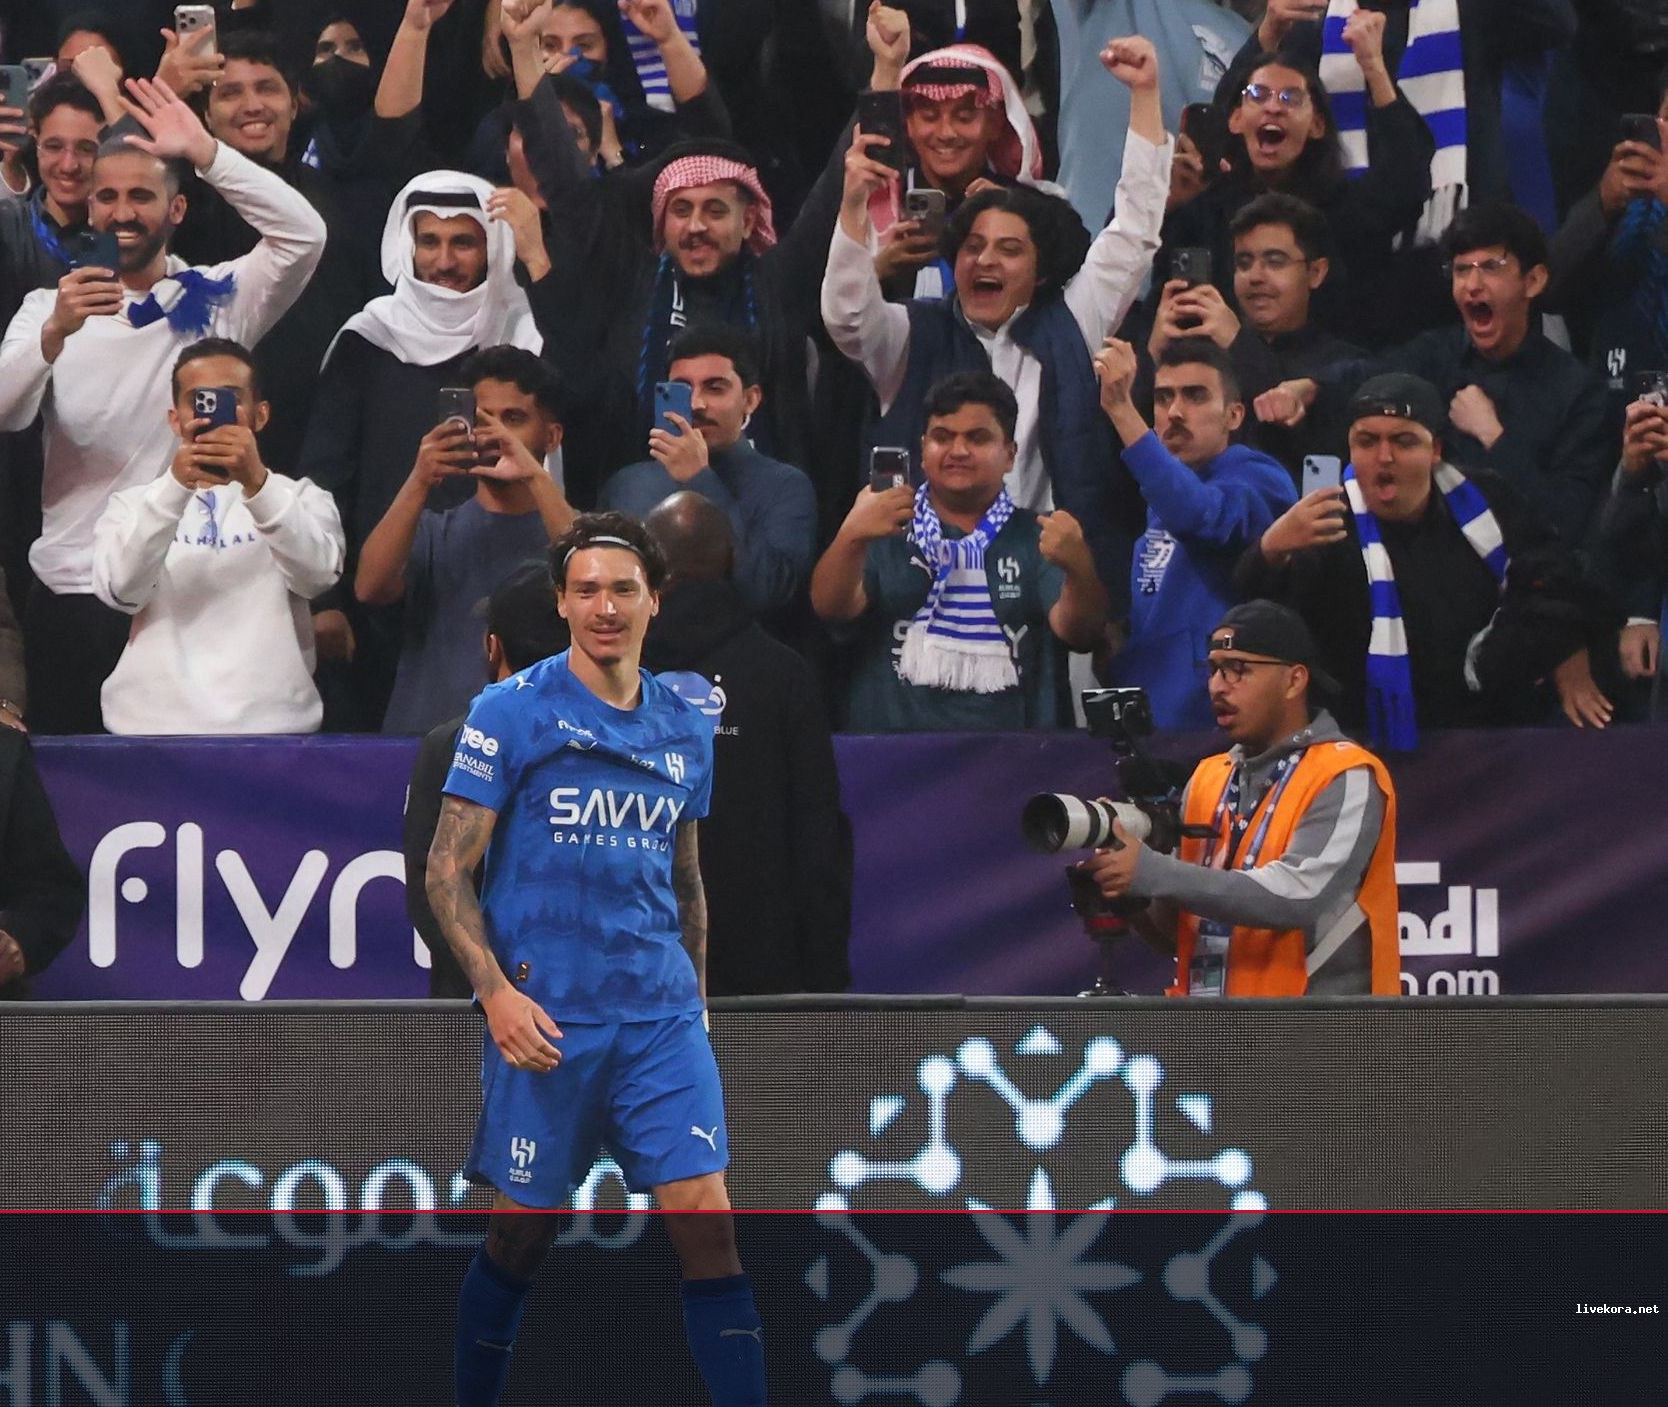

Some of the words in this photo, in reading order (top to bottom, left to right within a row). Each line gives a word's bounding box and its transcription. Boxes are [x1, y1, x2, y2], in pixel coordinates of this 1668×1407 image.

[549, 787, 686, 834] SAVVY
[554, 831, 618, 848] GAMES
[627, 835, 669, 854] GROU
[88, 821, 434, 1002] flyn
